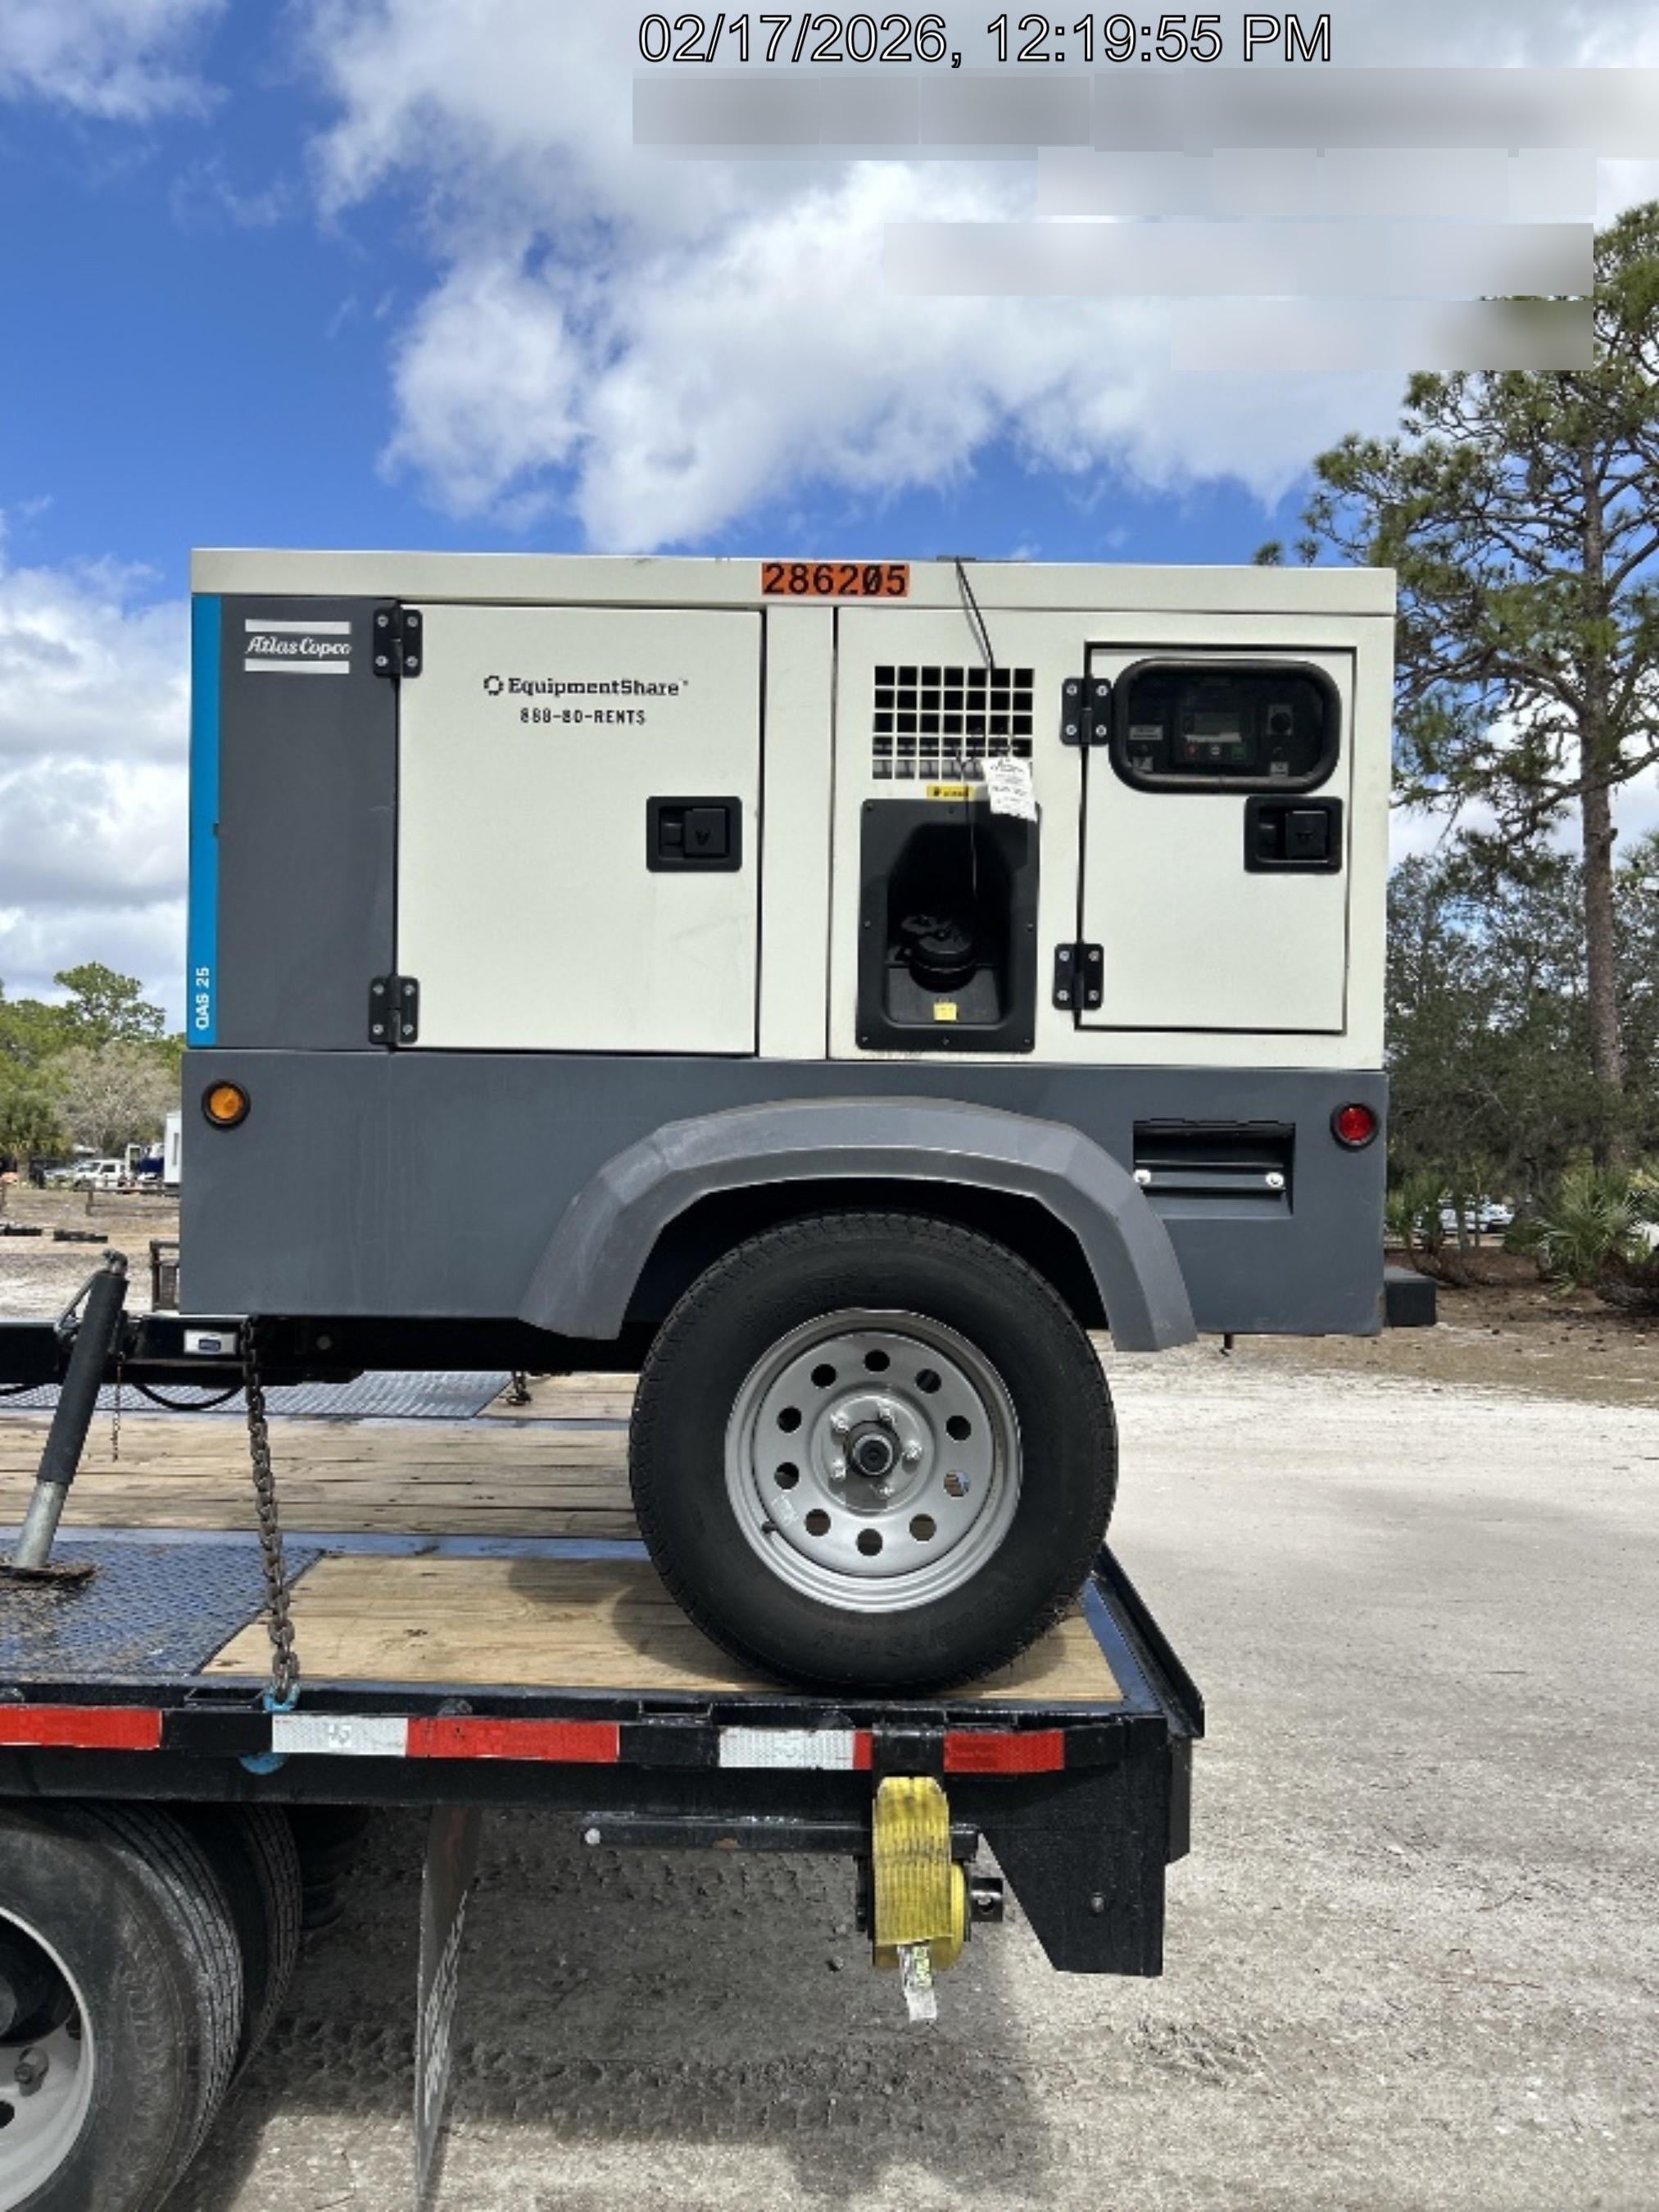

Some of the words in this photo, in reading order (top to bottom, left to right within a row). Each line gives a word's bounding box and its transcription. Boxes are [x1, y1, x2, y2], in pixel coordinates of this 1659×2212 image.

[764, 563, 905, 596] 286205
[245, 636, 298, 655] Atlas
[298, 636, 351, 659] Copco
[195, 965, 210, 989] 25
[195, 992, 210, 1031] QAS
